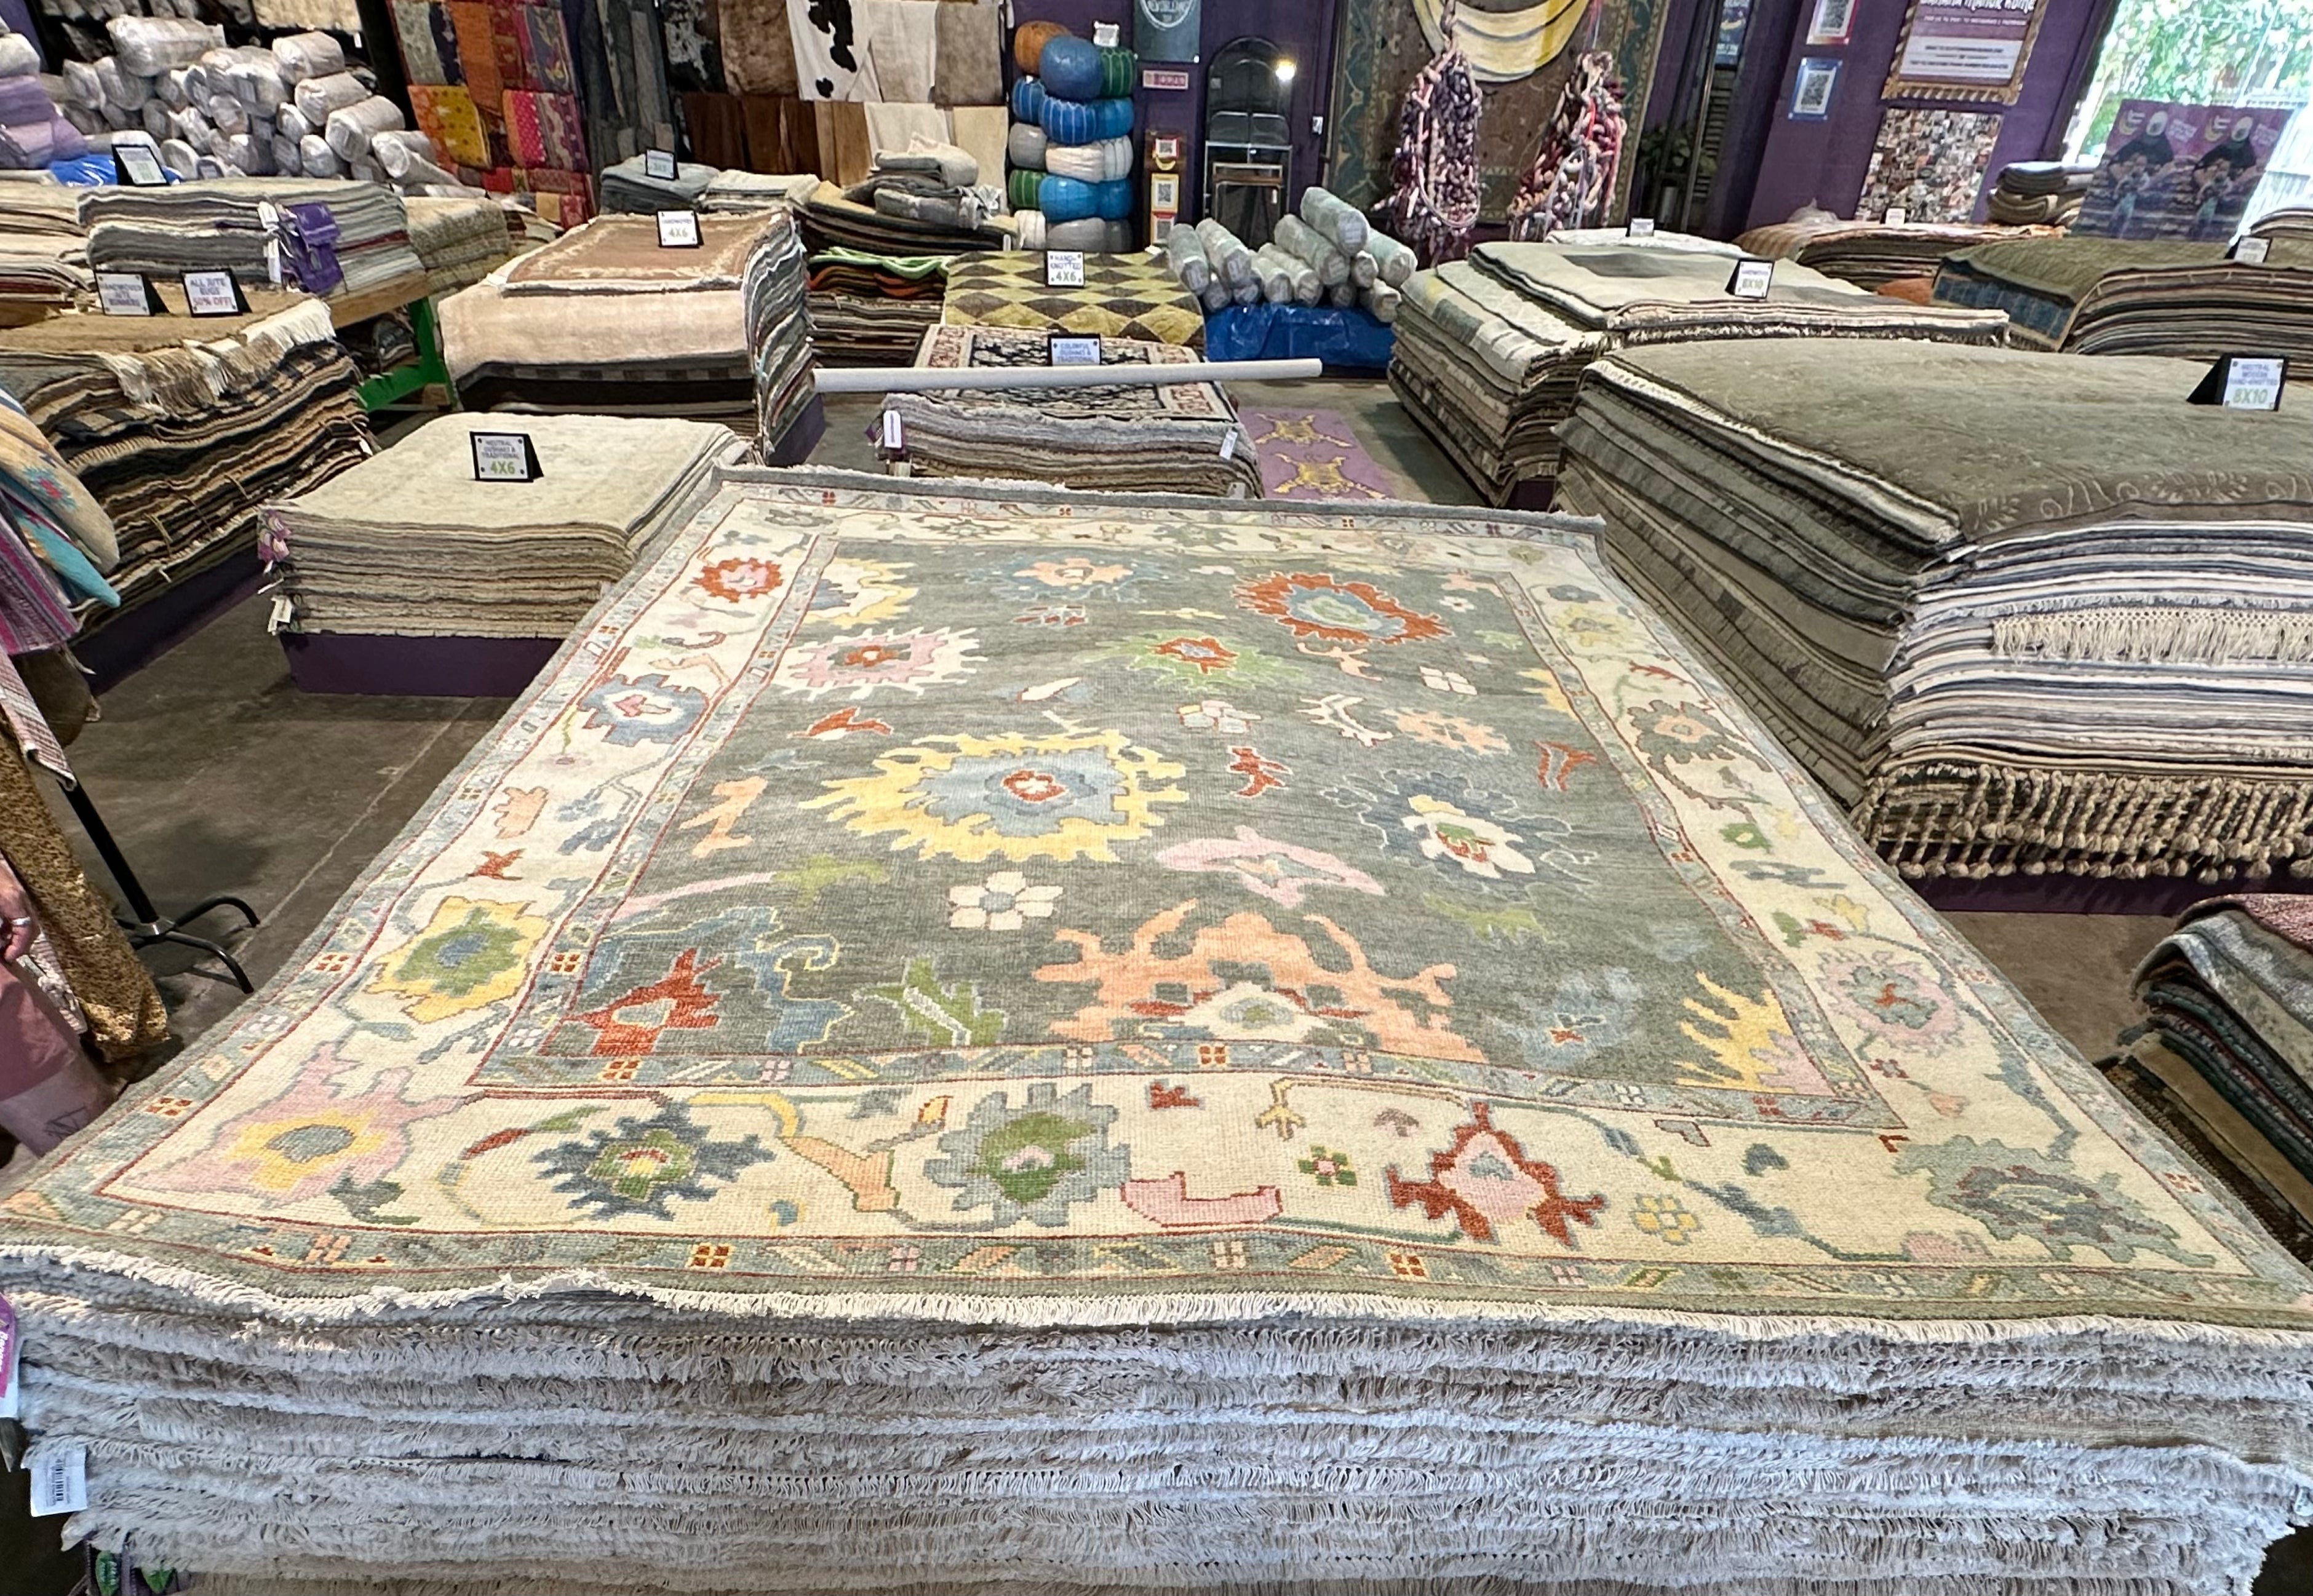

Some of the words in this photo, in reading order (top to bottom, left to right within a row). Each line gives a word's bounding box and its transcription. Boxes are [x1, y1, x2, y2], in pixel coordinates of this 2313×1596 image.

[669, 227, 688, 238] 4X6
[1056, 271, 1077, 282] 4X6
[2232, 388, 2268, 404] 8X10
[490, 461, 516, 475] 4X6
